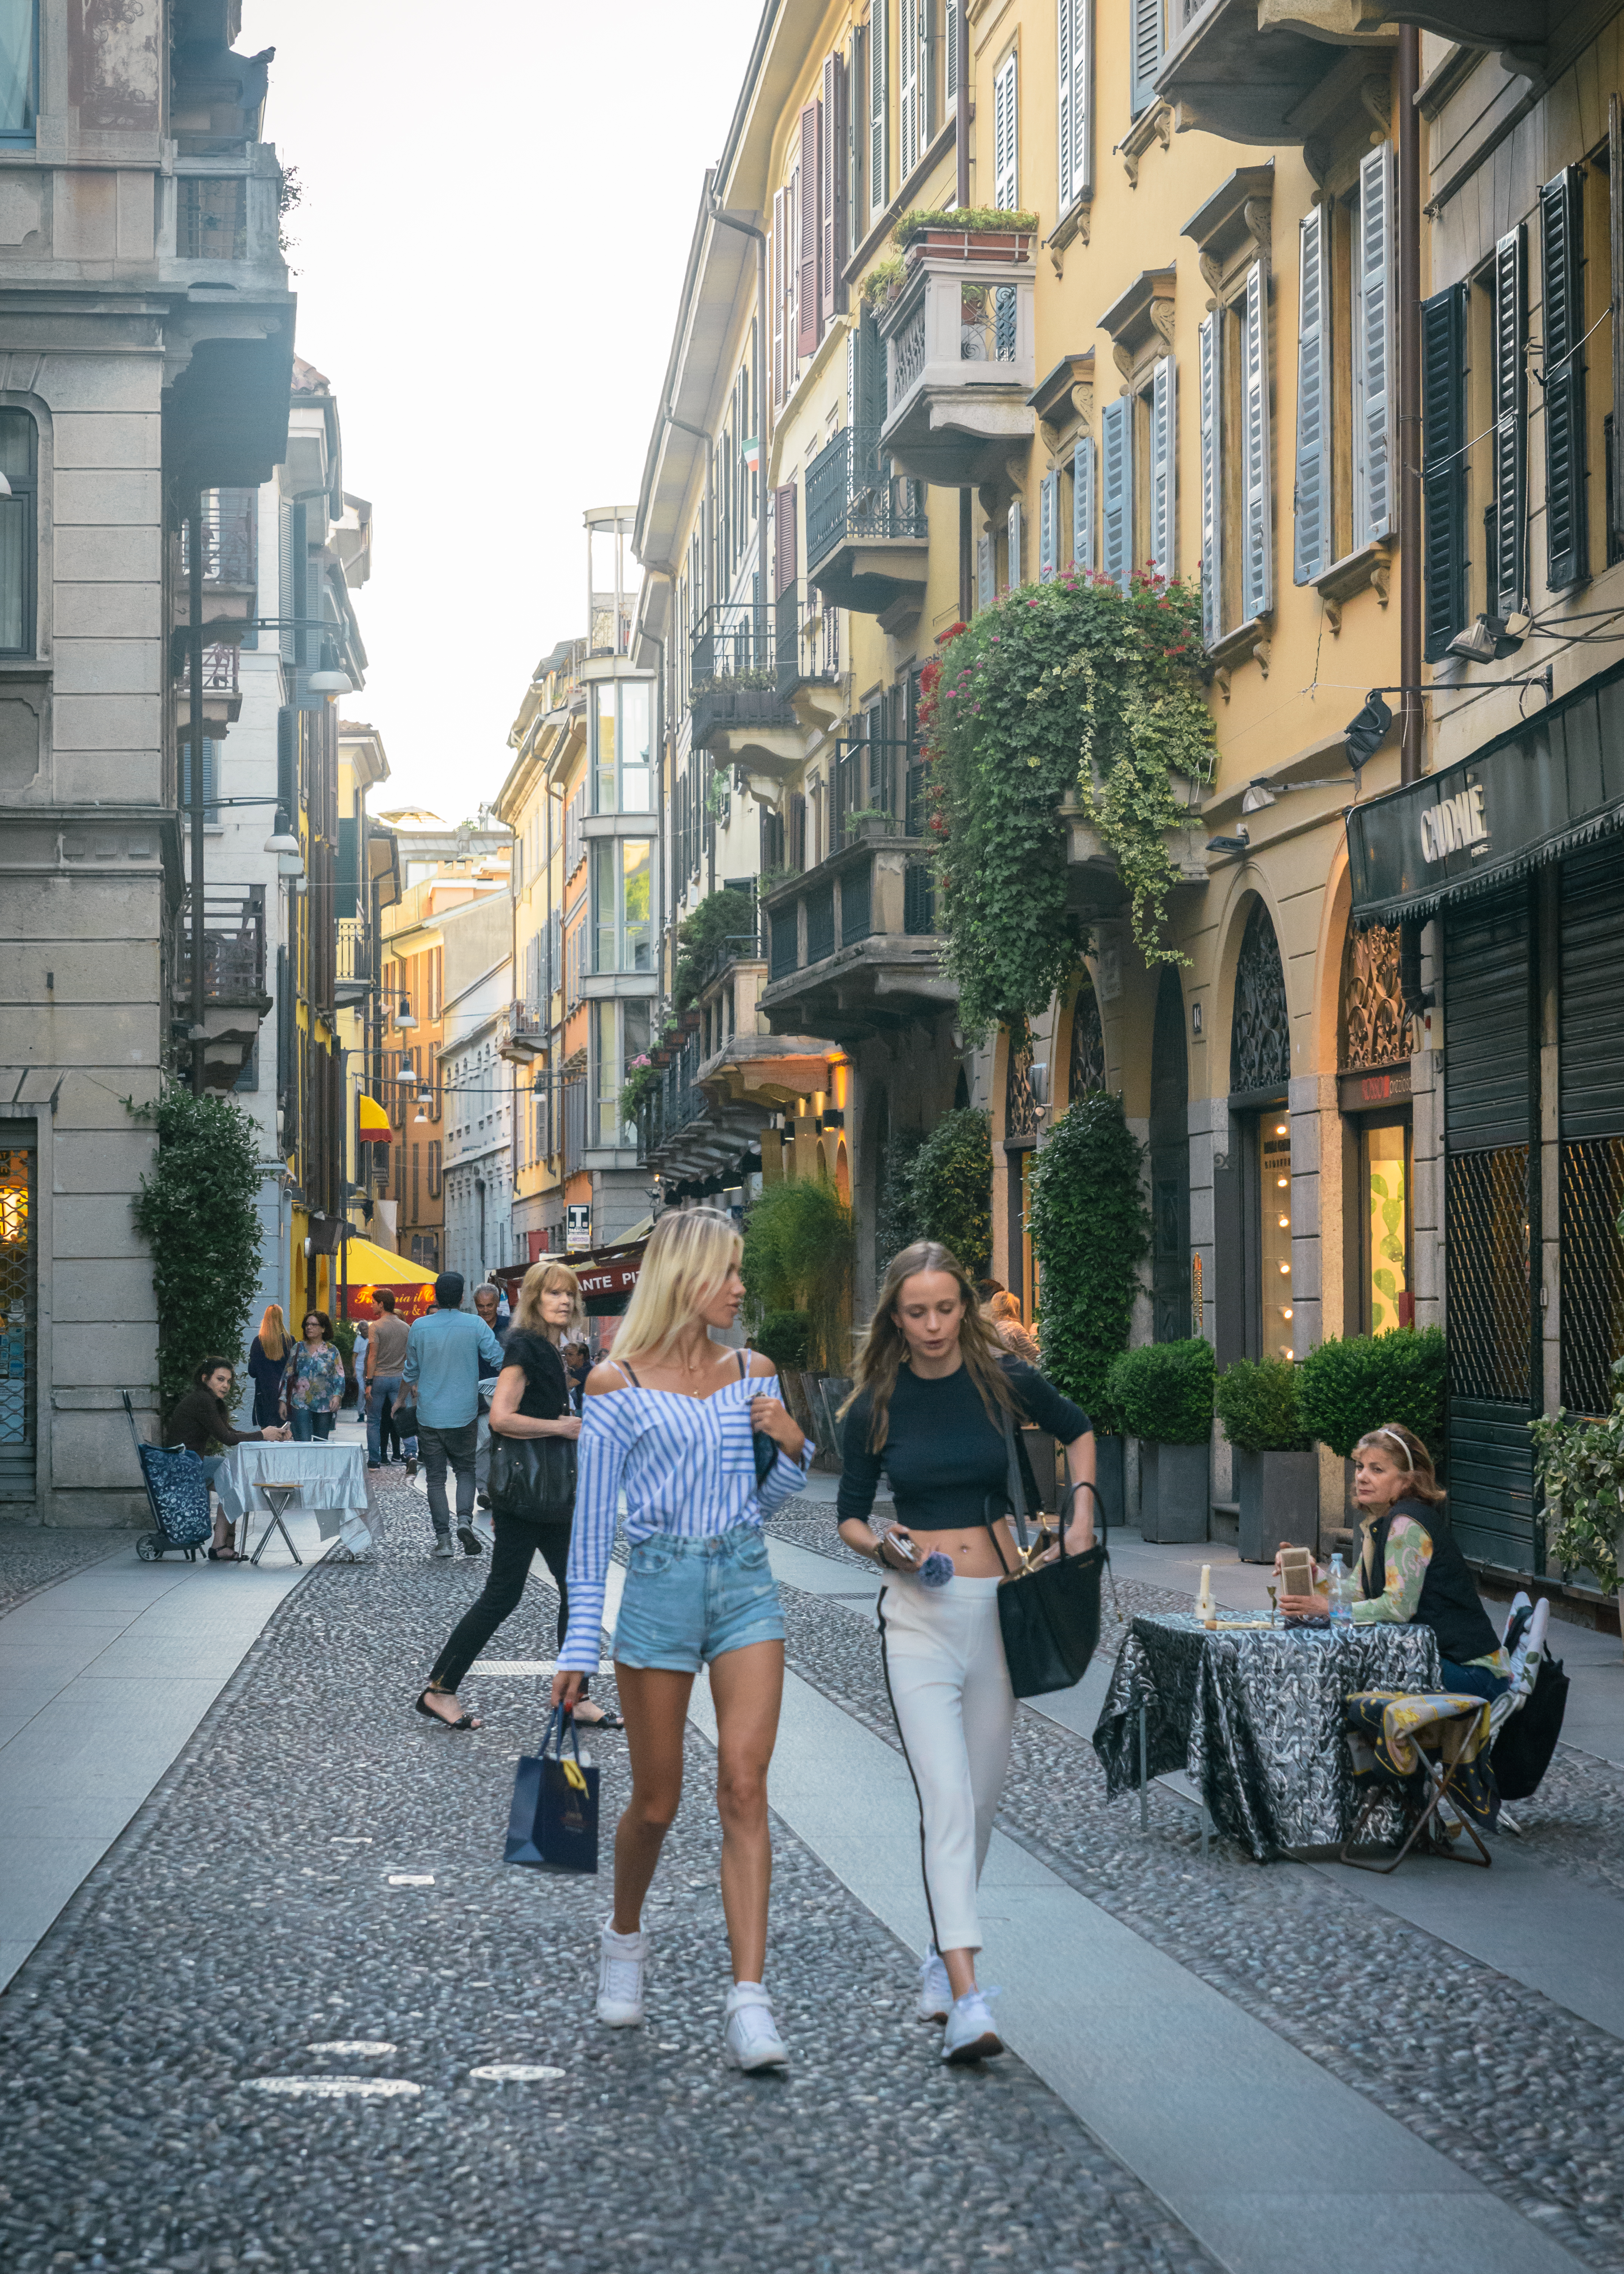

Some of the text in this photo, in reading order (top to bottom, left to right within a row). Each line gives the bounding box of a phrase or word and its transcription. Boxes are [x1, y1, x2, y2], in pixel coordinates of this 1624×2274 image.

[1362, 1076, 1383, 1101] ROSSO
[570, 1207, 587, 1227] T
[577, 1275, 612, 1291] ANTE
[355, 1291, 411, 1303] Traria
